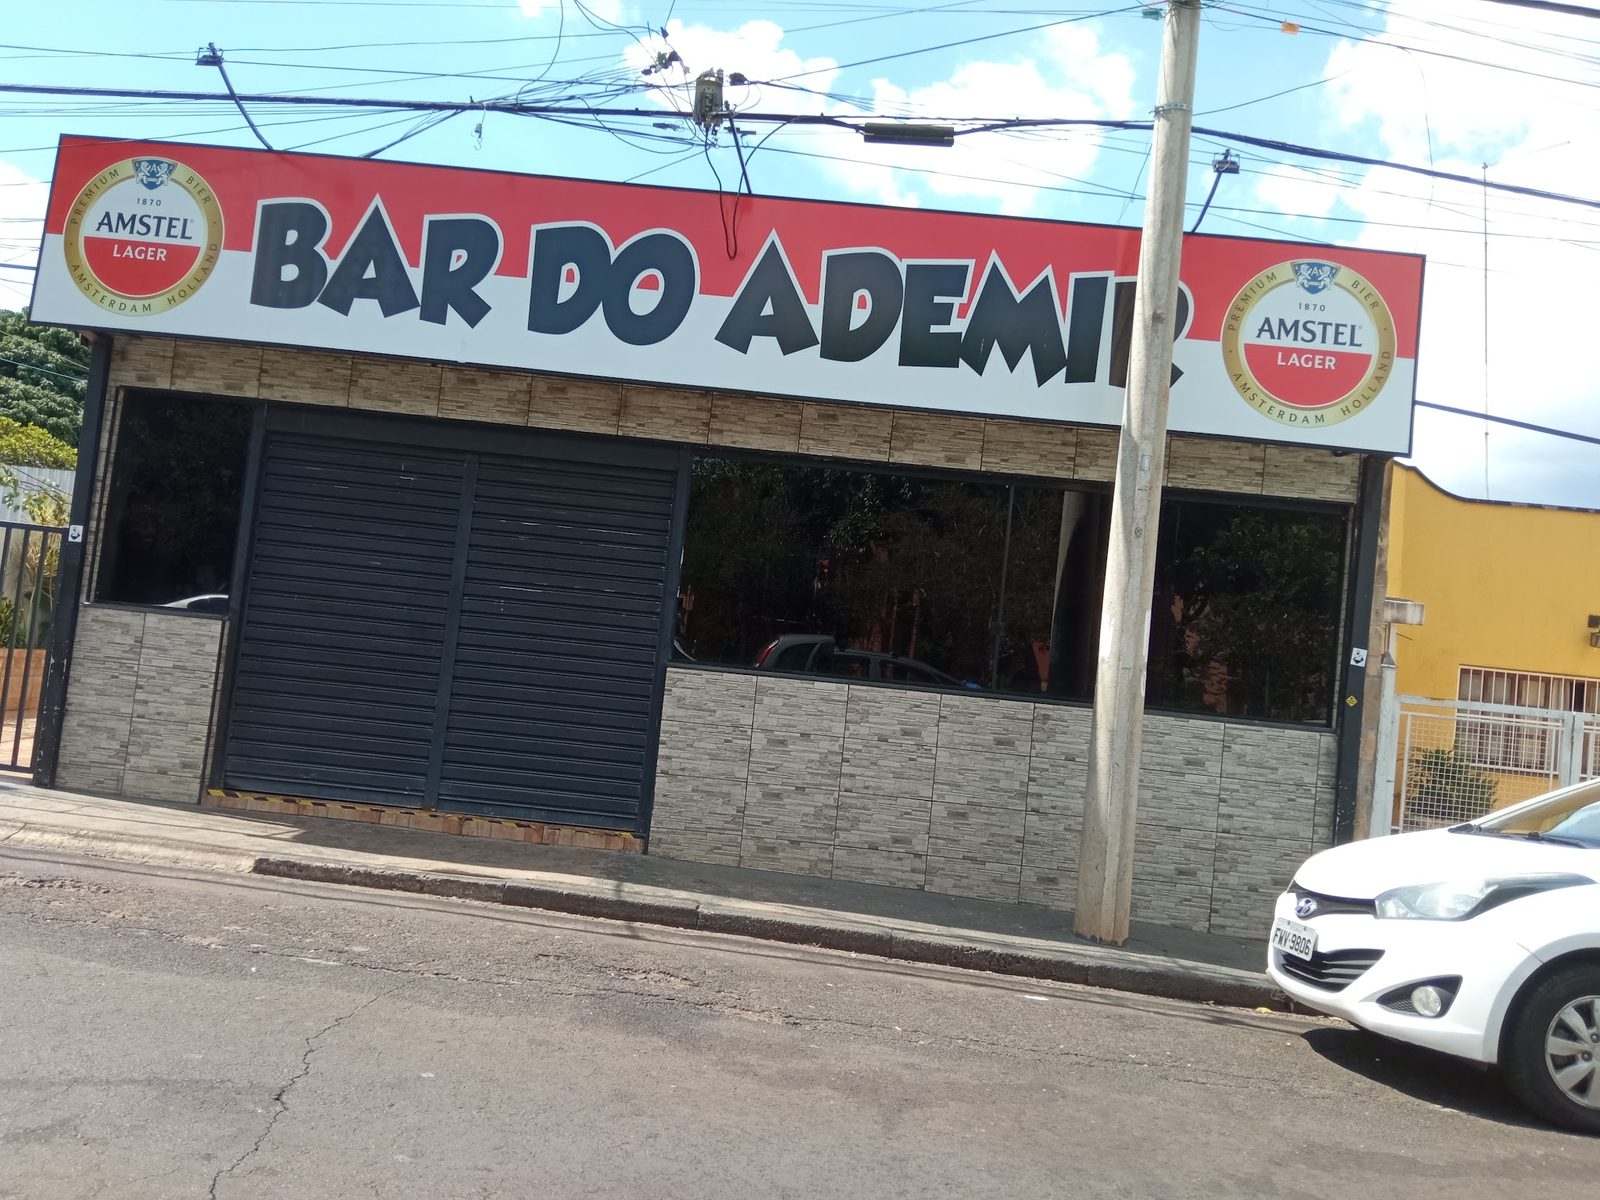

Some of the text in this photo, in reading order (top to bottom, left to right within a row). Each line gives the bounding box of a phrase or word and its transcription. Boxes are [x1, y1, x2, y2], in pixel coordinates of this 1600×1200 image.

[70, 168, 212, 225] PREMIUM BIER
[136, 197, 162, 207] 1870
[96, 211, 193, 240] AMSTEL
[112, 244, 168, 262] LAGER
[71, 243, 218, 313] AMSTERDAM HOLLAND
[250, 197, 503, 329] BAR
[527, 221, 700, 346] DO
[1227, 271, 1379, 332] PREMIUM BIER
[1298, 302, 1326, 312] 1870
[1255, 316, 1362, 348] AMSTEL
[1276, 351, 1337, 370] LAGER
[1232, 350, 1390, 425] AMSTERDAM HOLLAND
